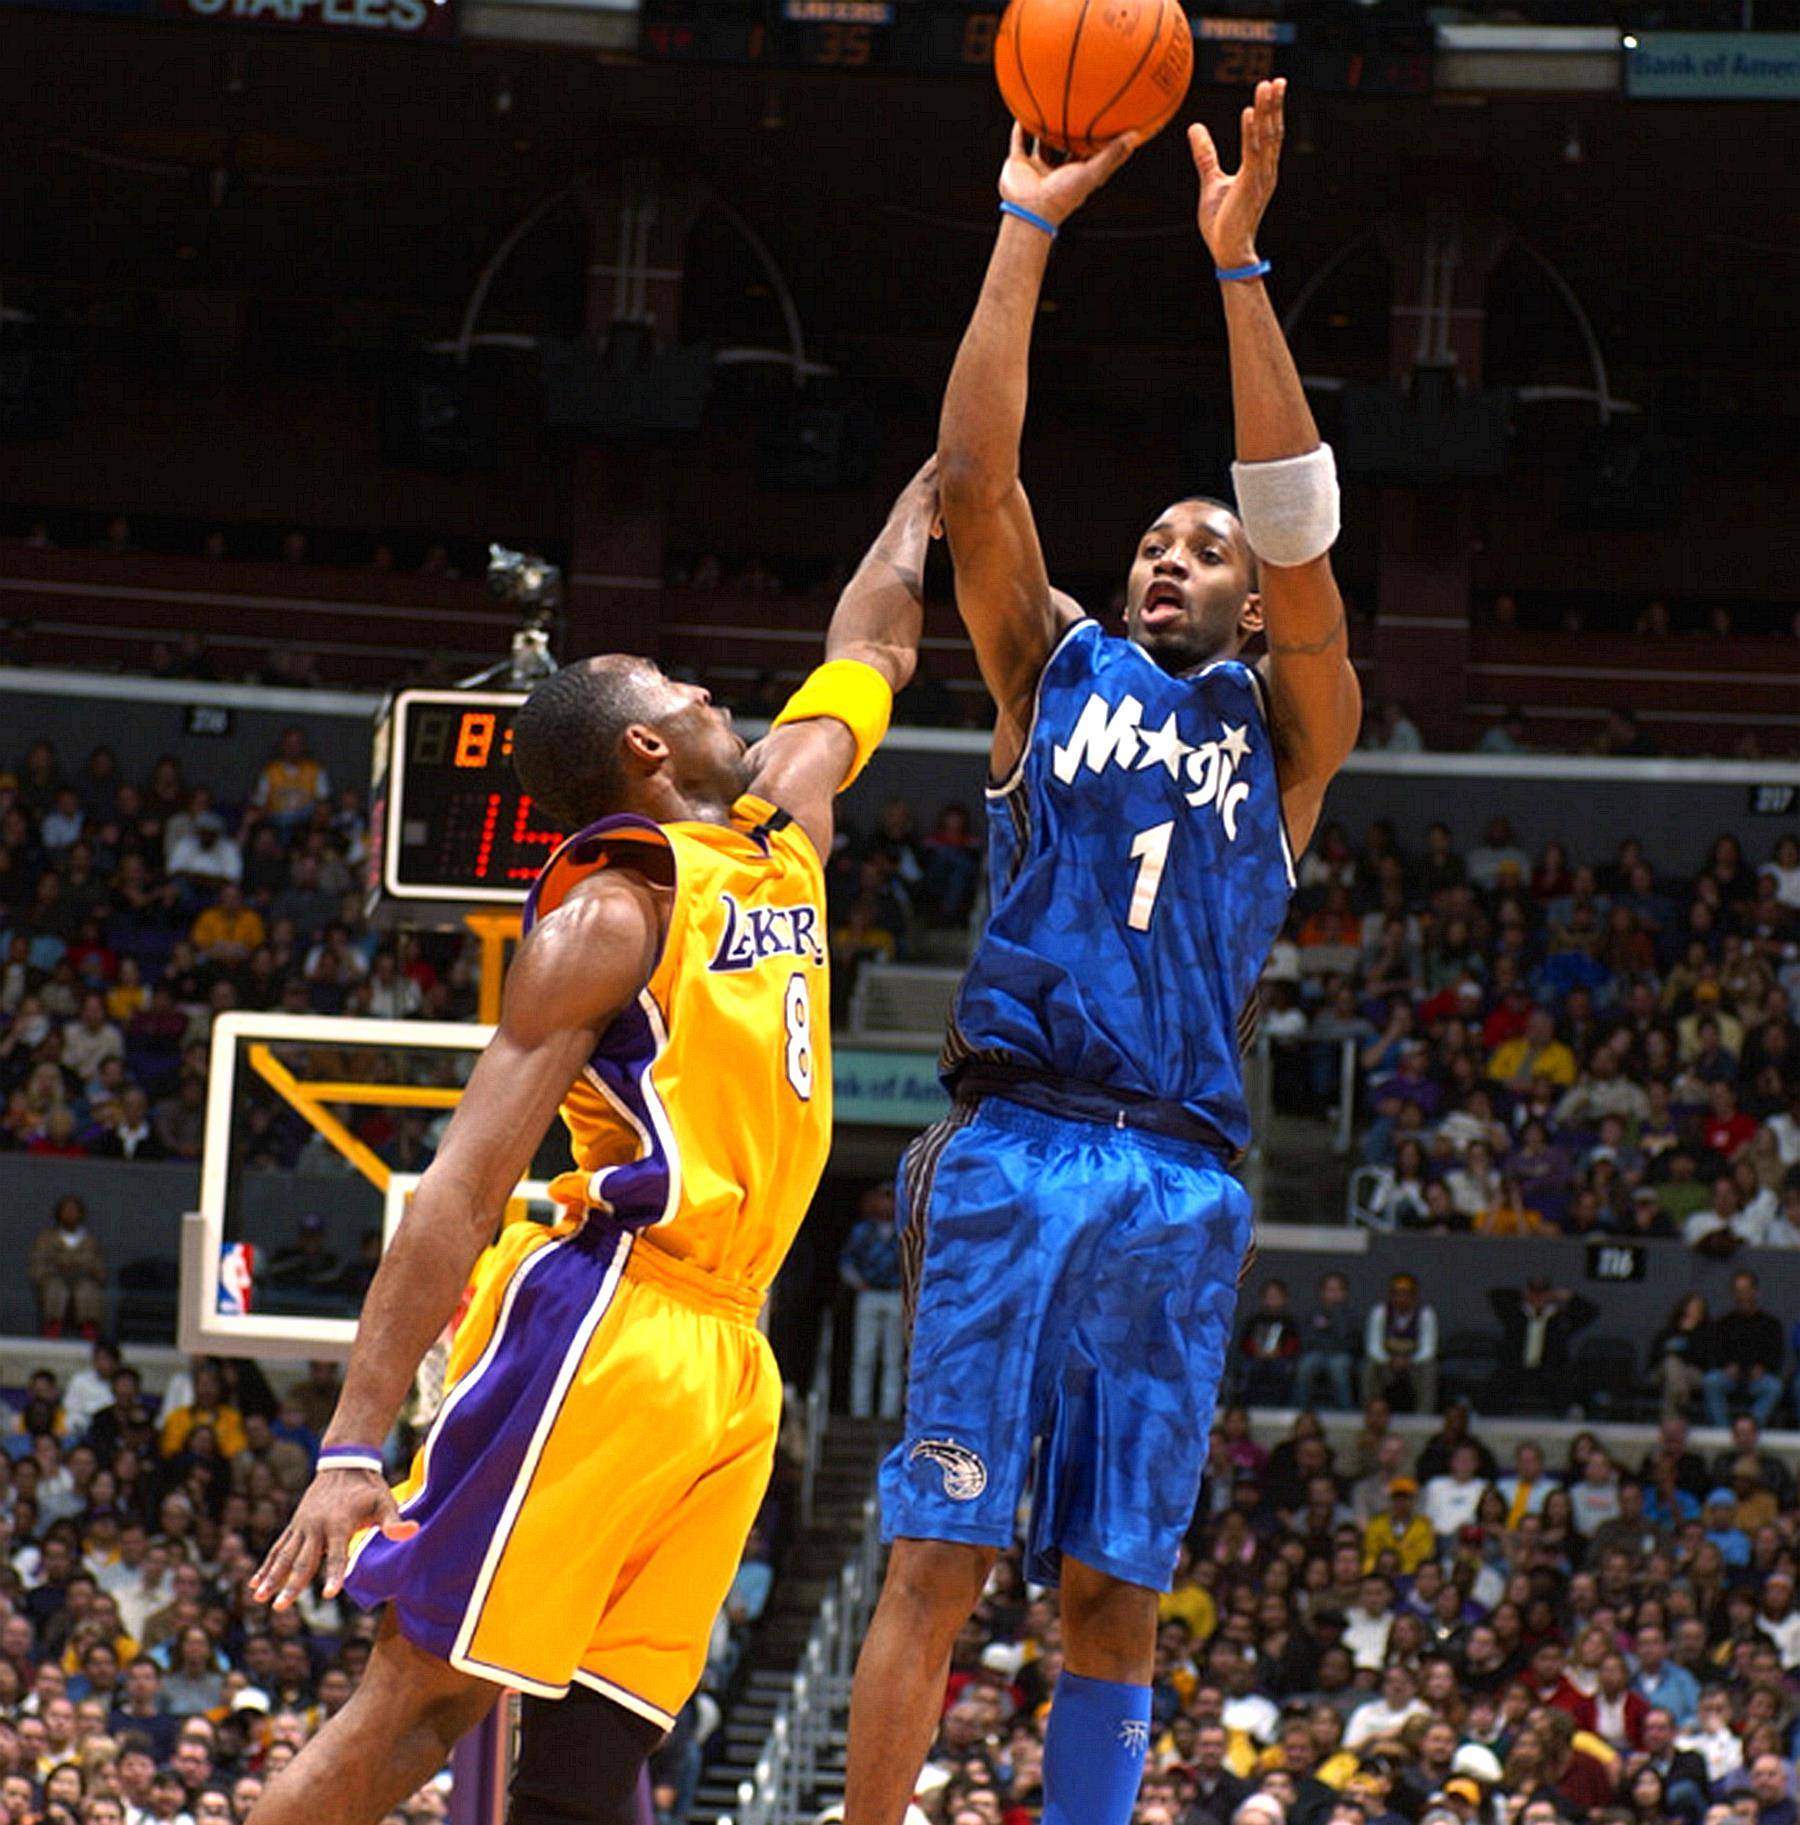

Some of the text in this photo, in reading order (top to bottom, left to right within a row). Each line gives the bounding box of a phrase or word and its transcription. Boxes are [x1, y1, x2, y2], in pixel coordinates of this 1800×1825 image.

[1702, 53, 1726, 77] of
[1127, 820, 1175, 932] 1
[783, 971, 815, 1103] 8
